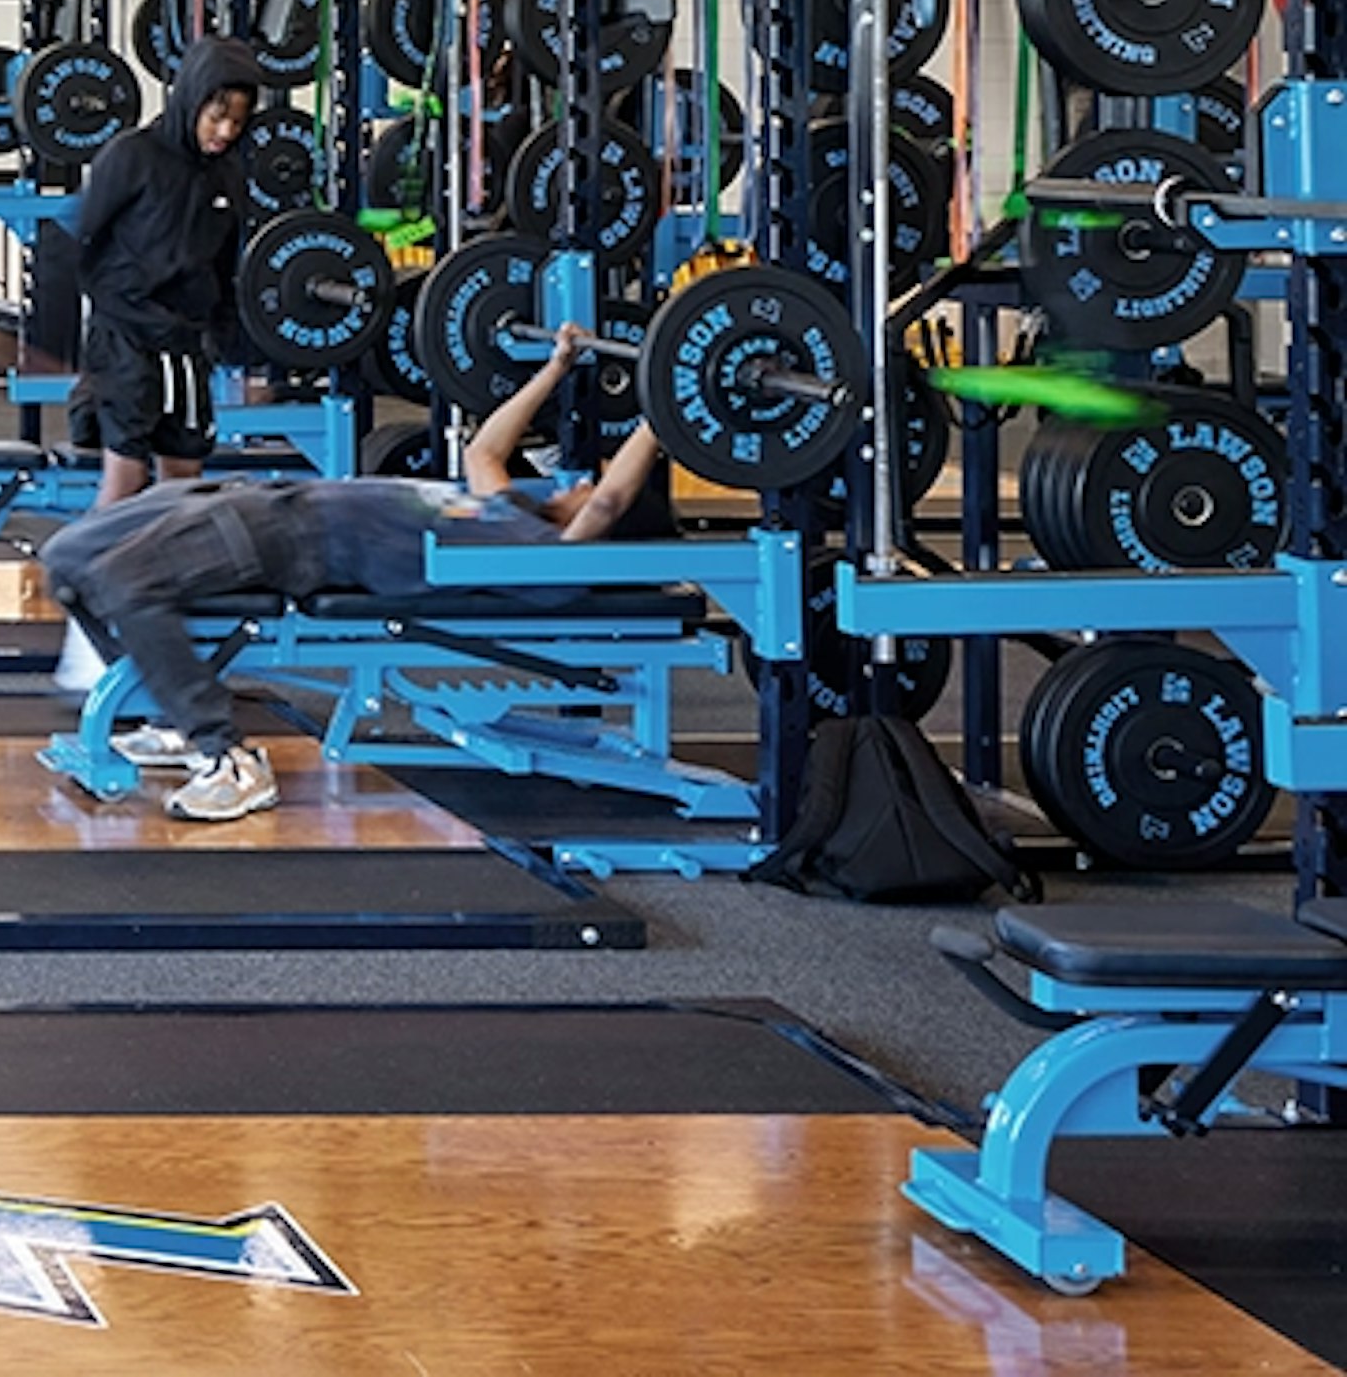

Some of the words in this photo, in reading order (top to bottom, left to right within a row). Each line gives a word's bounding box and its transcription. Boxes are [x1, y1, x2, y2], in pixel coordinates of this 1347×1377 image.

[598, 166, 645, 249] LAWSO
[671, 303, 735, 446] LAWSON
[1167, 422, 1279, 527] LAWSON
[1083, 685, 1141, 810] LIGHTNING
[1200, 693, 1252, 837] LAWSON
